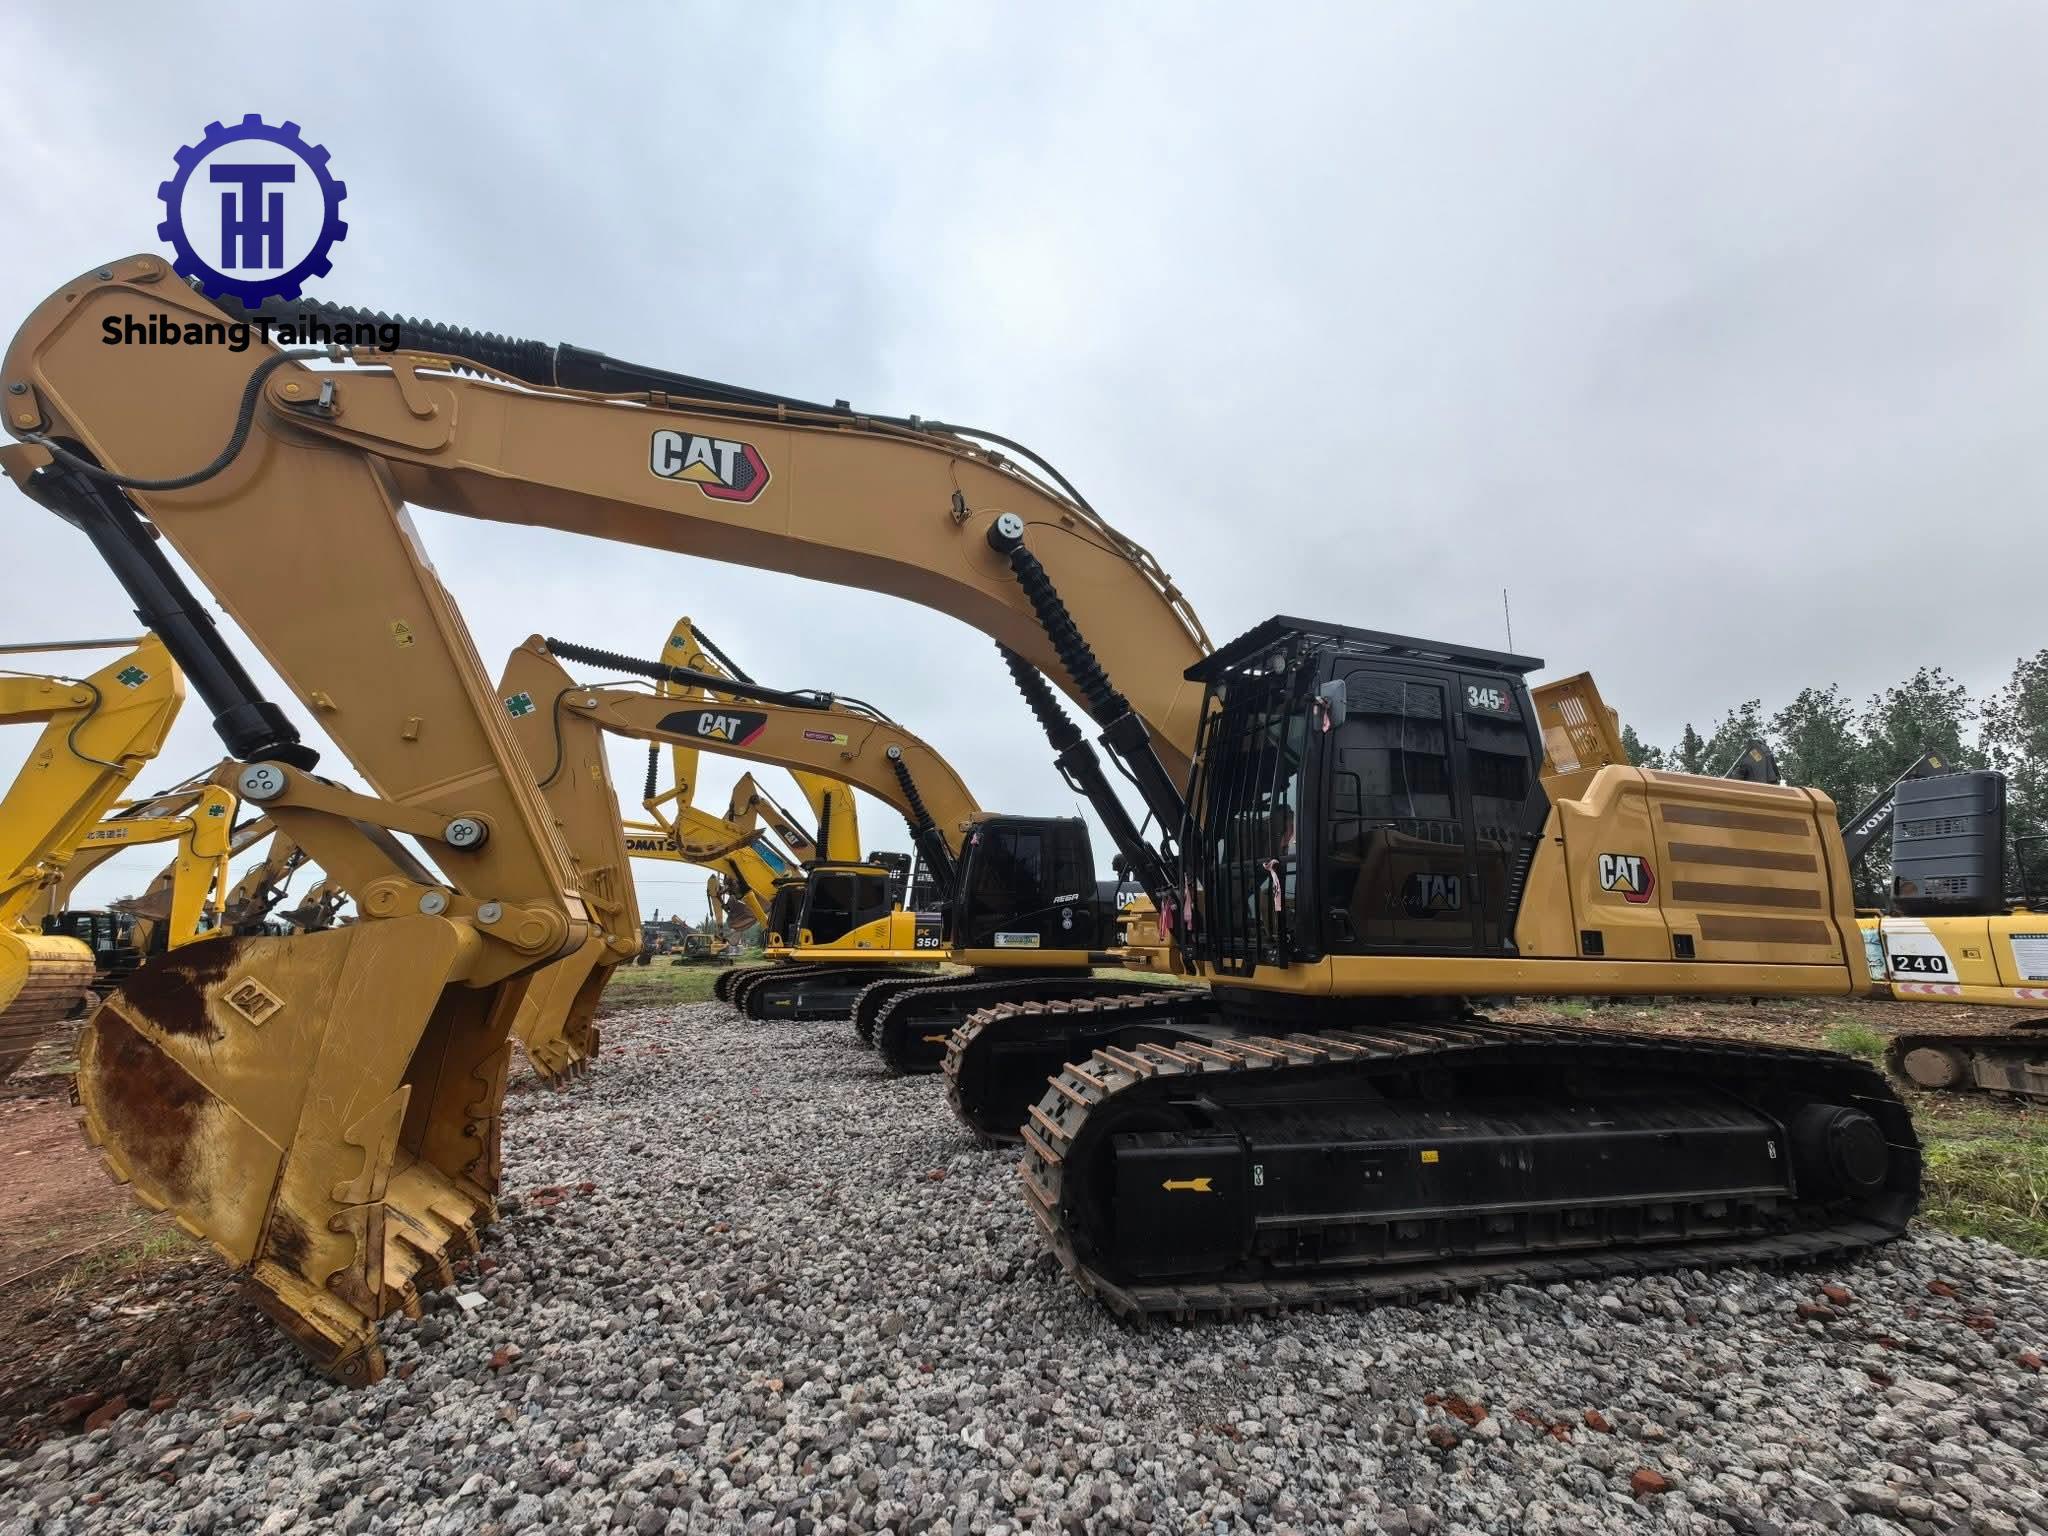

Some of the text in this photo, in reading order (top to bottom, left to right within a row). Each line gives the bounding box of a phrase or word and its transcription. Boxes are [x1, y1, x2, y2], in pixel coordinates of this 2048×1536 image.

[653, 431, 742, 486] CAT
[1468, 686, 1499, 709] 345
[698, 713, 741, 740] CAT
[626, 840, 678, 851] OMATS
[1599, 855, 1641, 892] CAT
[917, 938, 939, 947] 350
[1897, 957, 1943, 972] 240
[232, 984, 276, 1019] CAT
